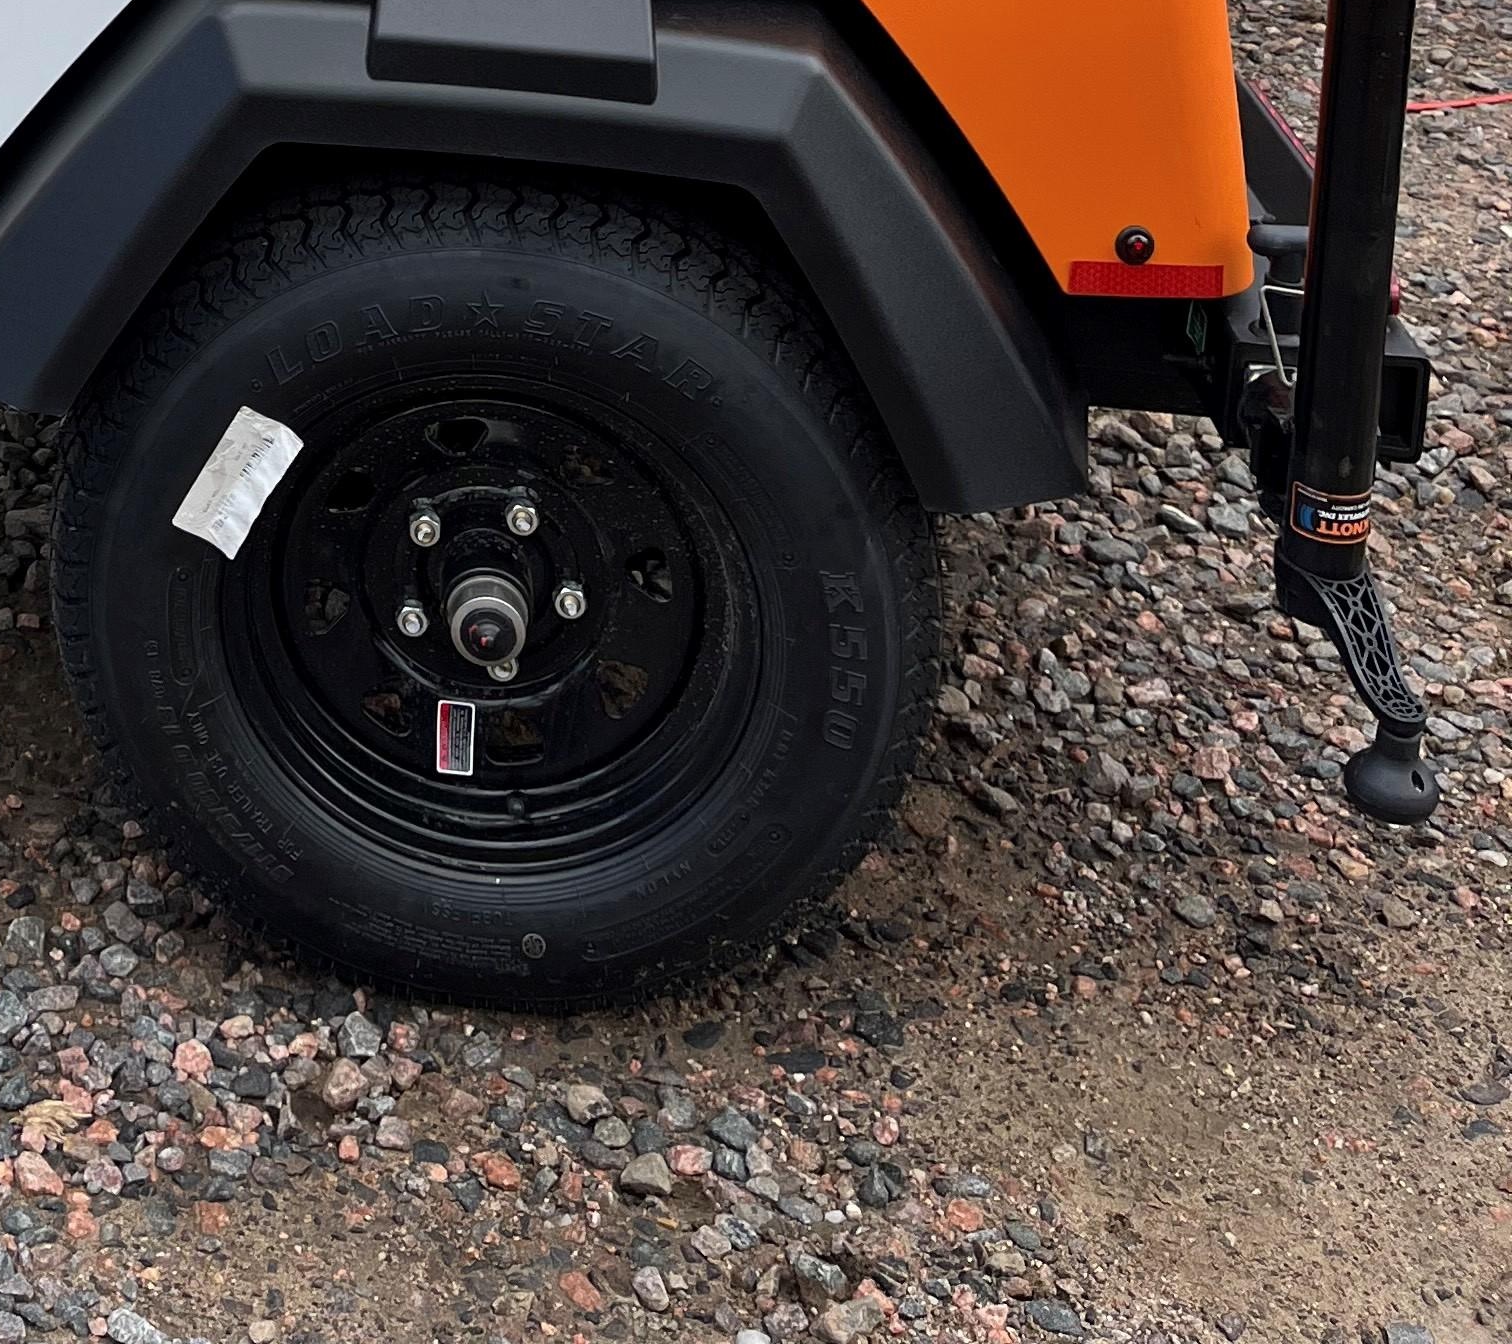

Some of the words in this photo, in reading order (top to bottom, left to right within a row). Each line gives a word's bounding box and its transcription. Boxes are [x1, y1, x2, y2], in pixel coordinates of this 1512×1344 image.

[264, 295, 446, 387] LOAD
[521, 297, 714, 400] STAR
[818, 568, 869, 751] K550
